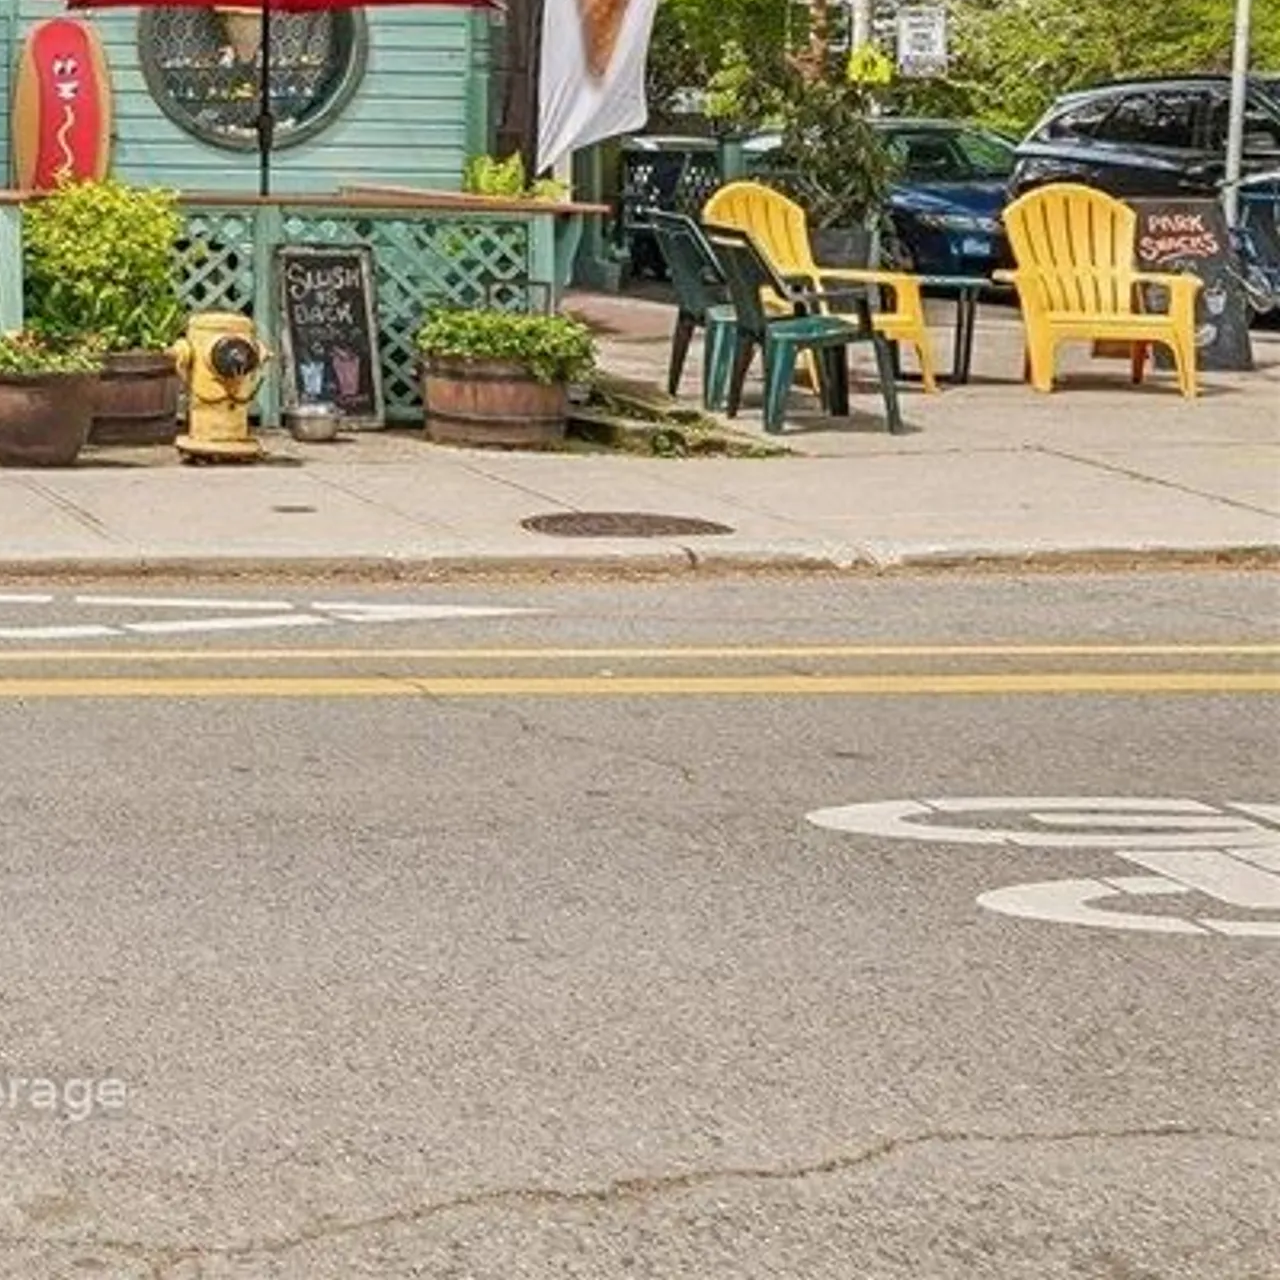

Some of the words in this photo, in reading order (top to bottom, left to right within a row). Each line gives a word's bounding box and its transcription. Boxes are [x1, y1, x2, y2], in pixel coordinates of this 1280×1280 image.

[1148, 214, 1205, 232] PARK
[288, 262, 360, 300] SLUSH
[294, 303, 354, 324] BACK
